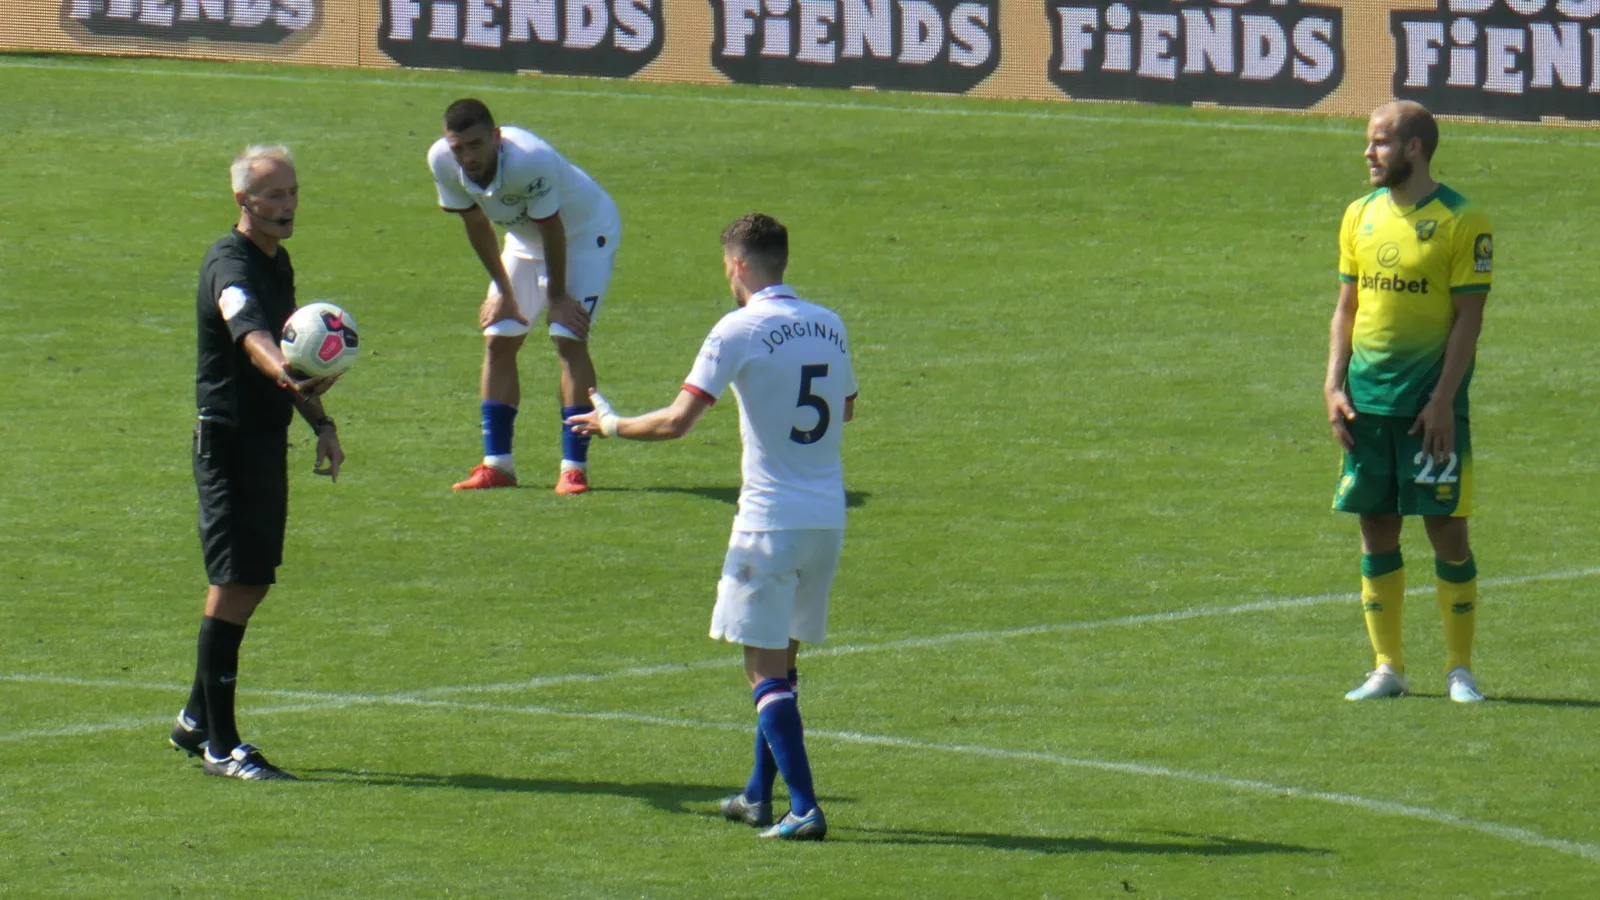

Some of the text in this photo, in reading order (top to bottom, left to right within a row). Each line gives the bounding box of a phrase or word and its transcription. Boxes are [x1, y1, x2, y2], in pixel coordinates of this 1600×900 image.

[1361, 270, 1429, 294] dafabet
[789, 363, 830, 445] 5
[1413, 451, 1458, 484] 22
